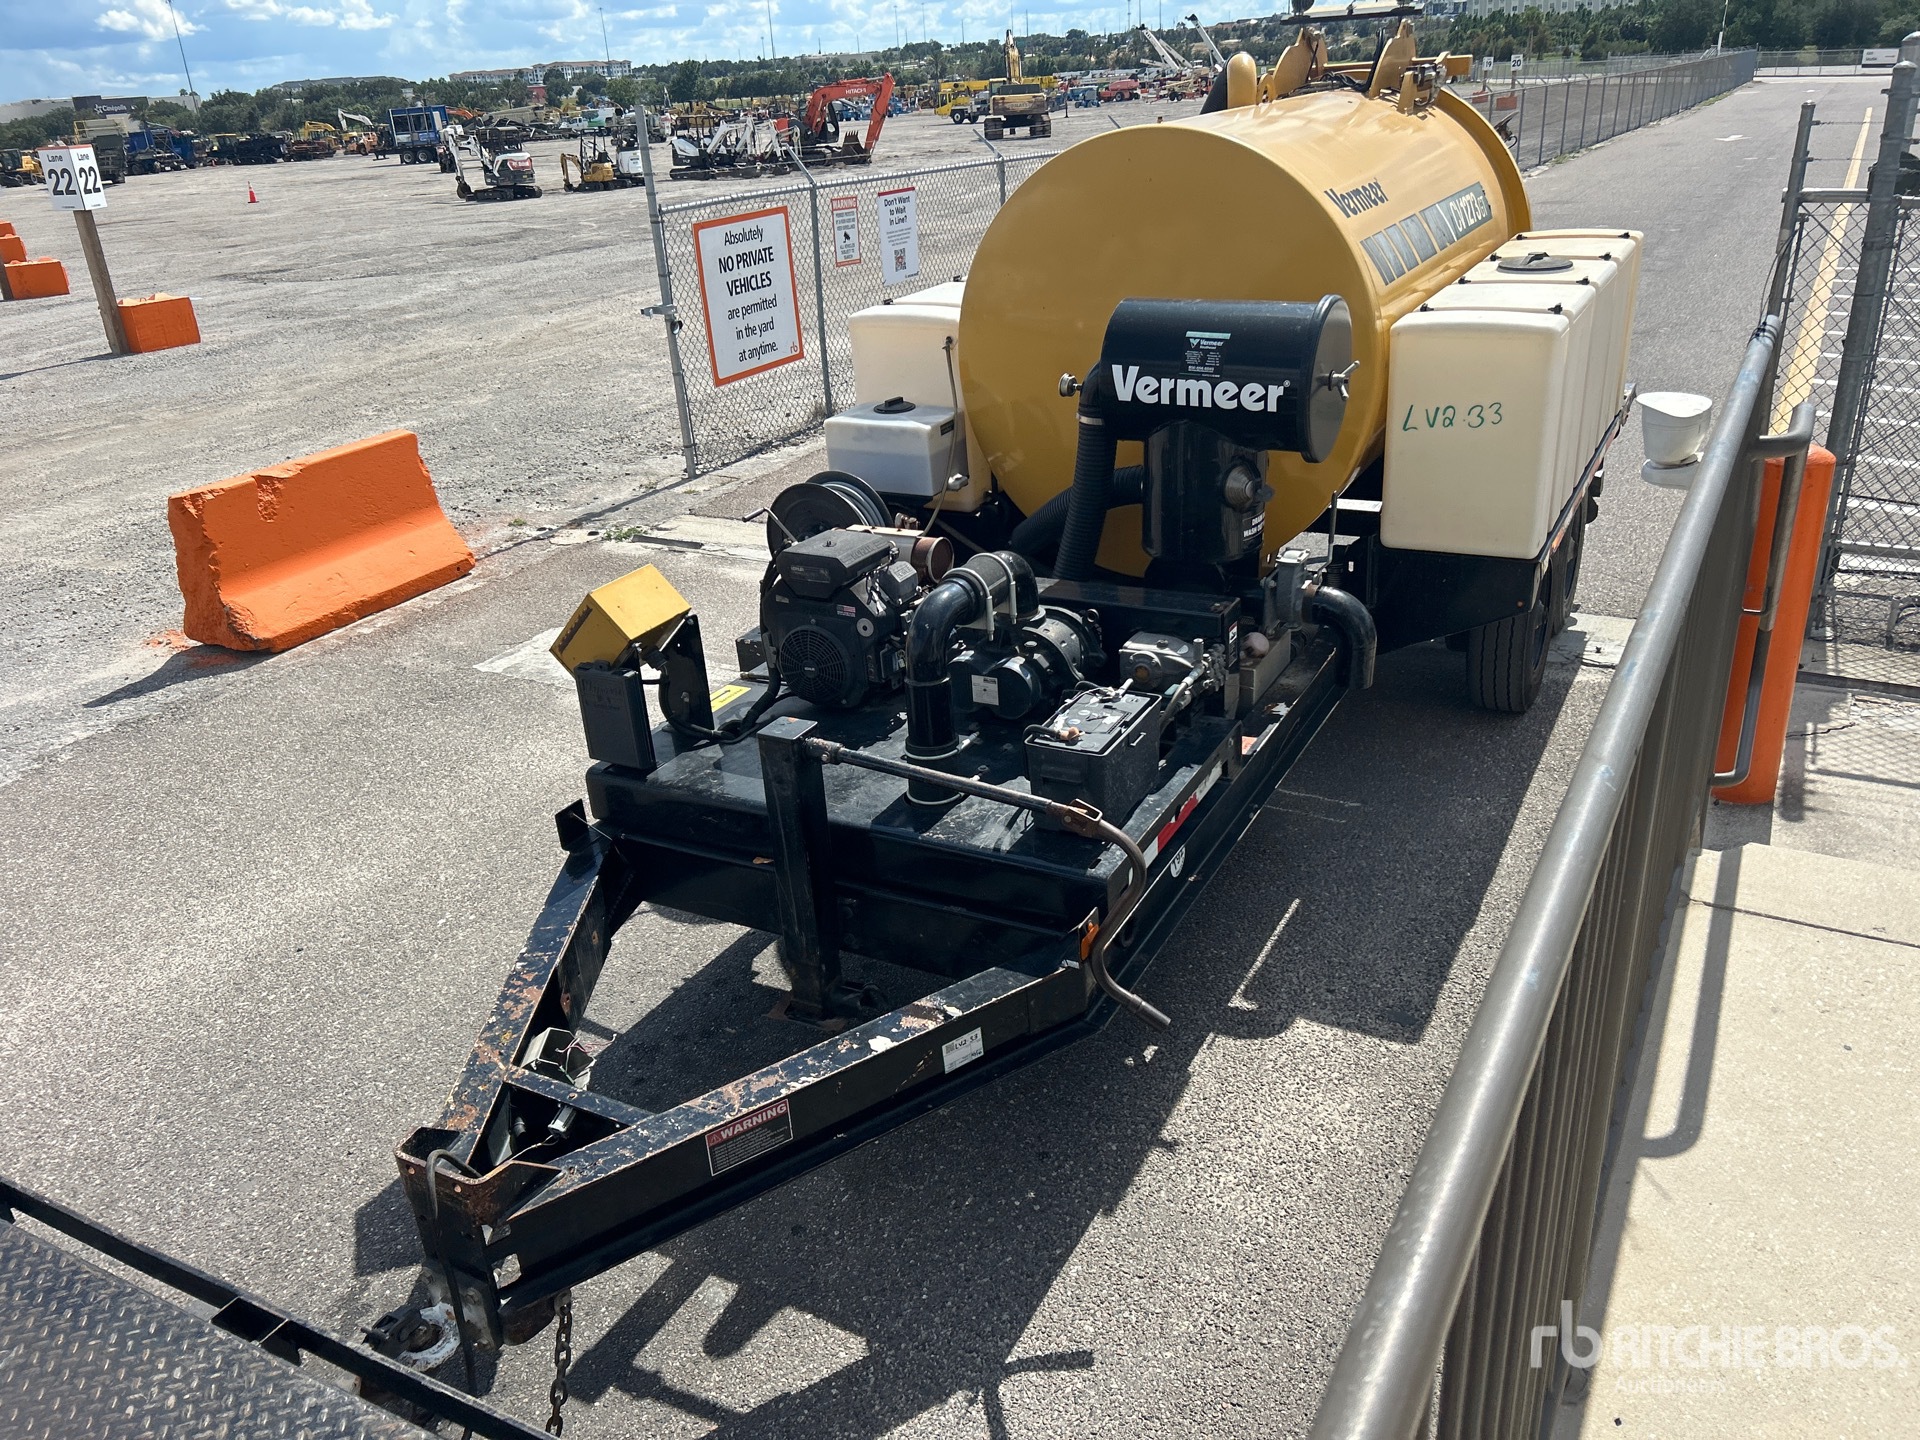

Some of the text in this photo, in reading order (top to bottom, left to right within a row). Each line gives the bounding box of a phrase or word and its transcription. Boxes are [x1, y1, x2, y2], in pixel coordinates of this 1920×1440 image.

[1512, 59, 1521, 67] 20
[46, 154, 63, 162] Lane
[76, 152, 90, 161] Lane
[47, 167, 77, 196] 22
[78, 165, 102, 195] 22
[884, 195, 910, 207] Don't Want
[889, 206, 906, 216] to Wait
[1324, 180, 1388, 218] Vermeer
[895, 215, 907, 225] Line?
[724, 225, 764, 246] Absolutely
[718, 246, 775, 274] NO PRIVATE
[726, 271, 772, 297] VEHICLES
[727, 294, 777, 321] are permitted
[735, 317, 775, 341] in the yard
[738, 341, 778, 363] at anytime.
[1111, 364, 1285, 413] Vermeer
[720, 1103, 787, 1139] WARNING
